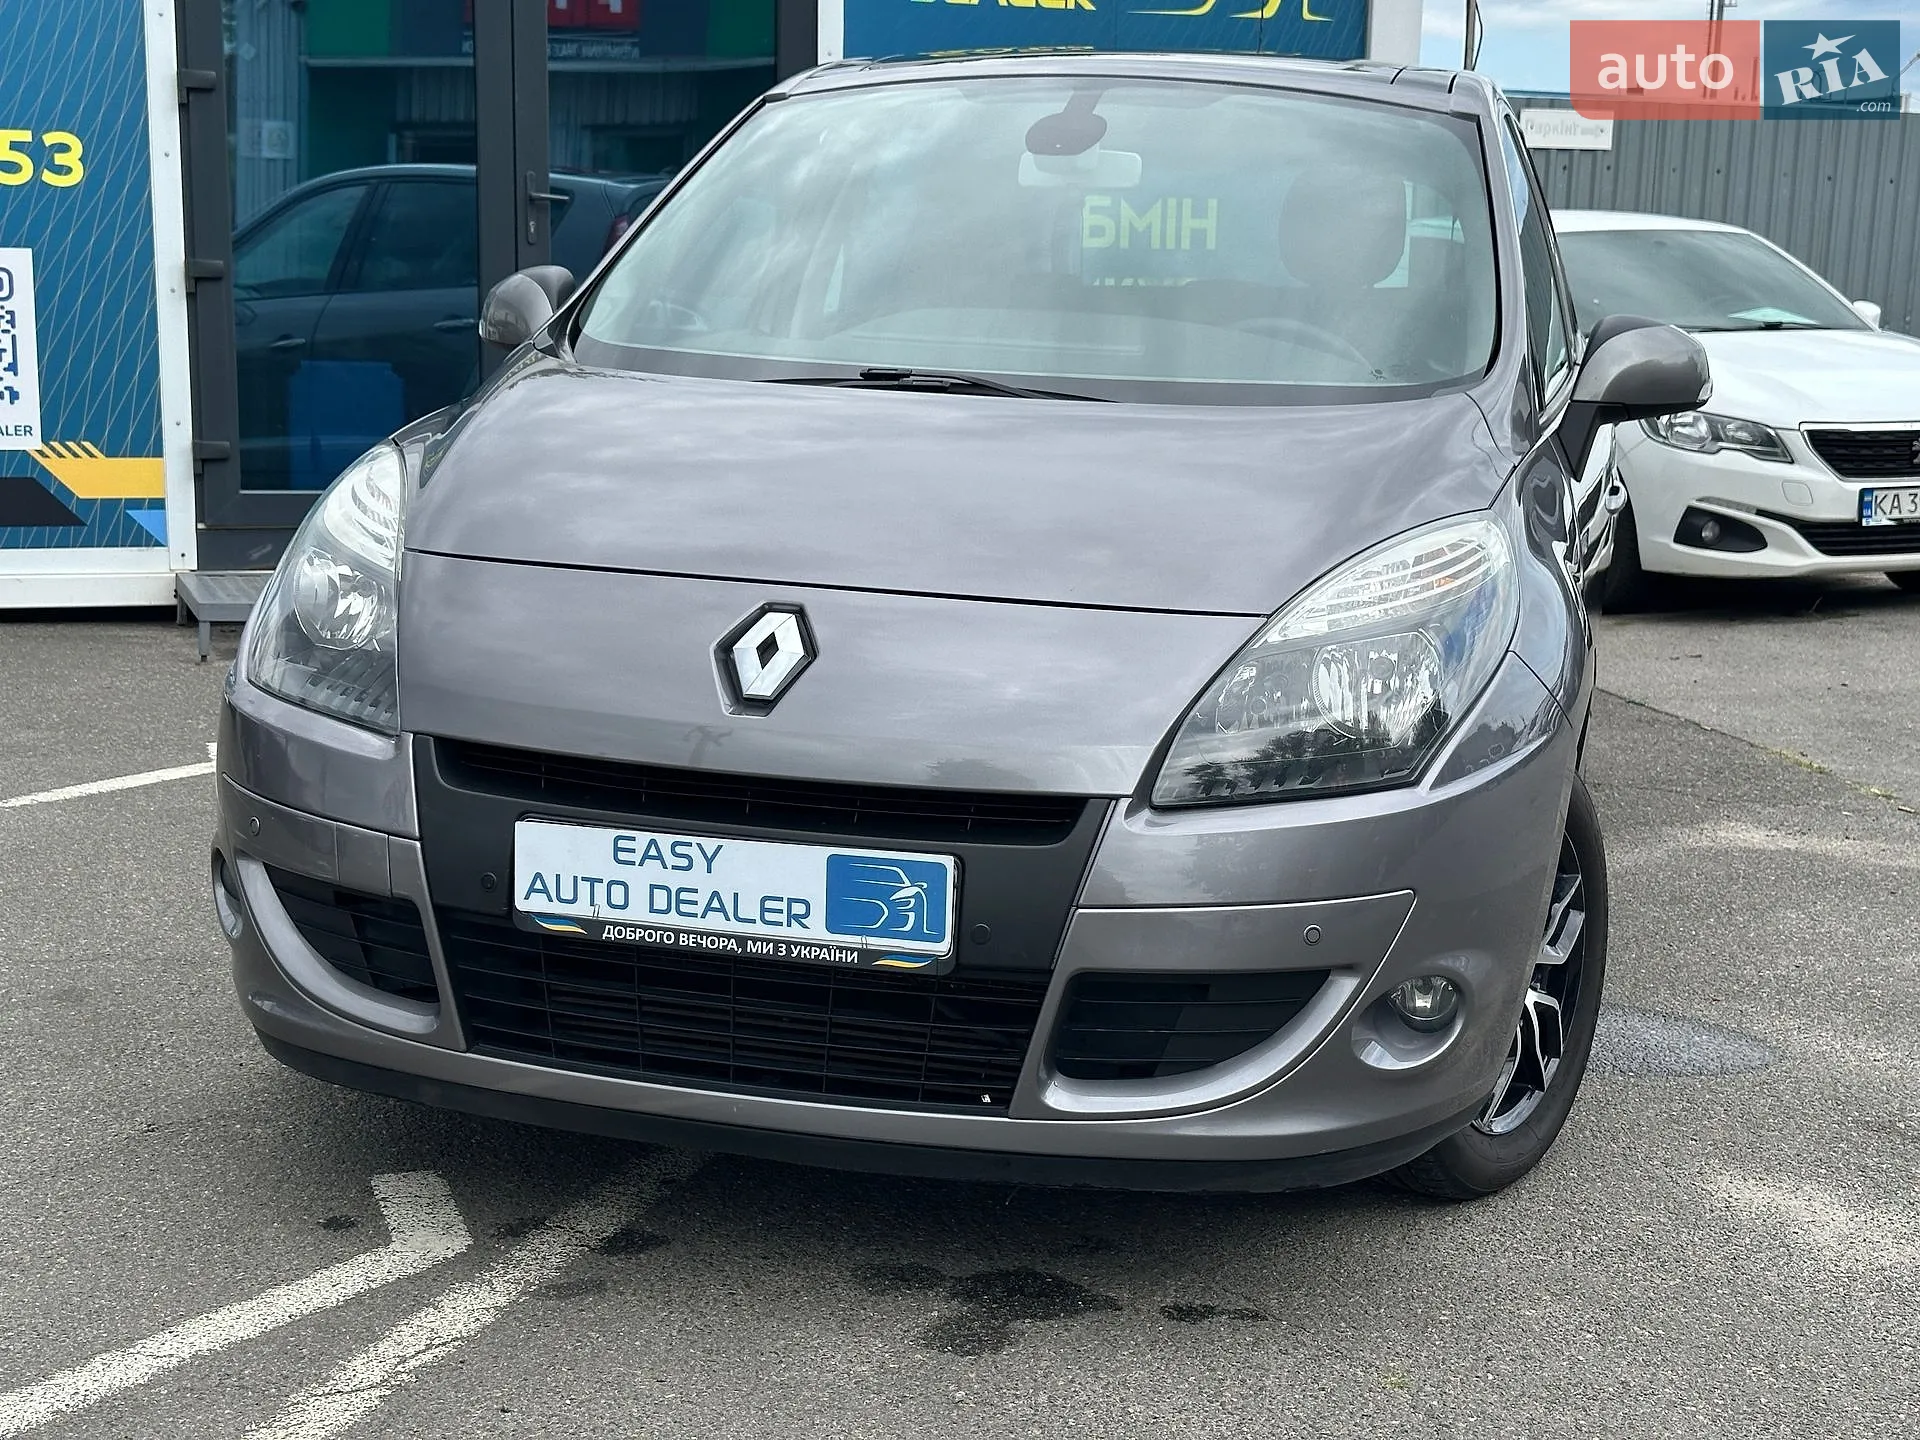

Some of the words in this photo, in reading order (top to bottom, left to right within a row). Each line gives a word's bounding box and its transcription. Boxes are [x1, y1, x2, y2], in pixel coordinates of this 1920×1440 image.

[0, 129, 84, 188] 53
[1874, 493, 1902, 516] KA
[612, 834, 724, 874] EASY
[523, 871, 630, 910] AUTO
[648, 883, 812, 930] DEALER
[602, 924, 676, 946] ДОБРОГО
[678, 933, 743, 954] ВЕЧОРА,
[746, 939, 774, 956] МИ
[790, 944, 859, 964] УКРАЇНИ
